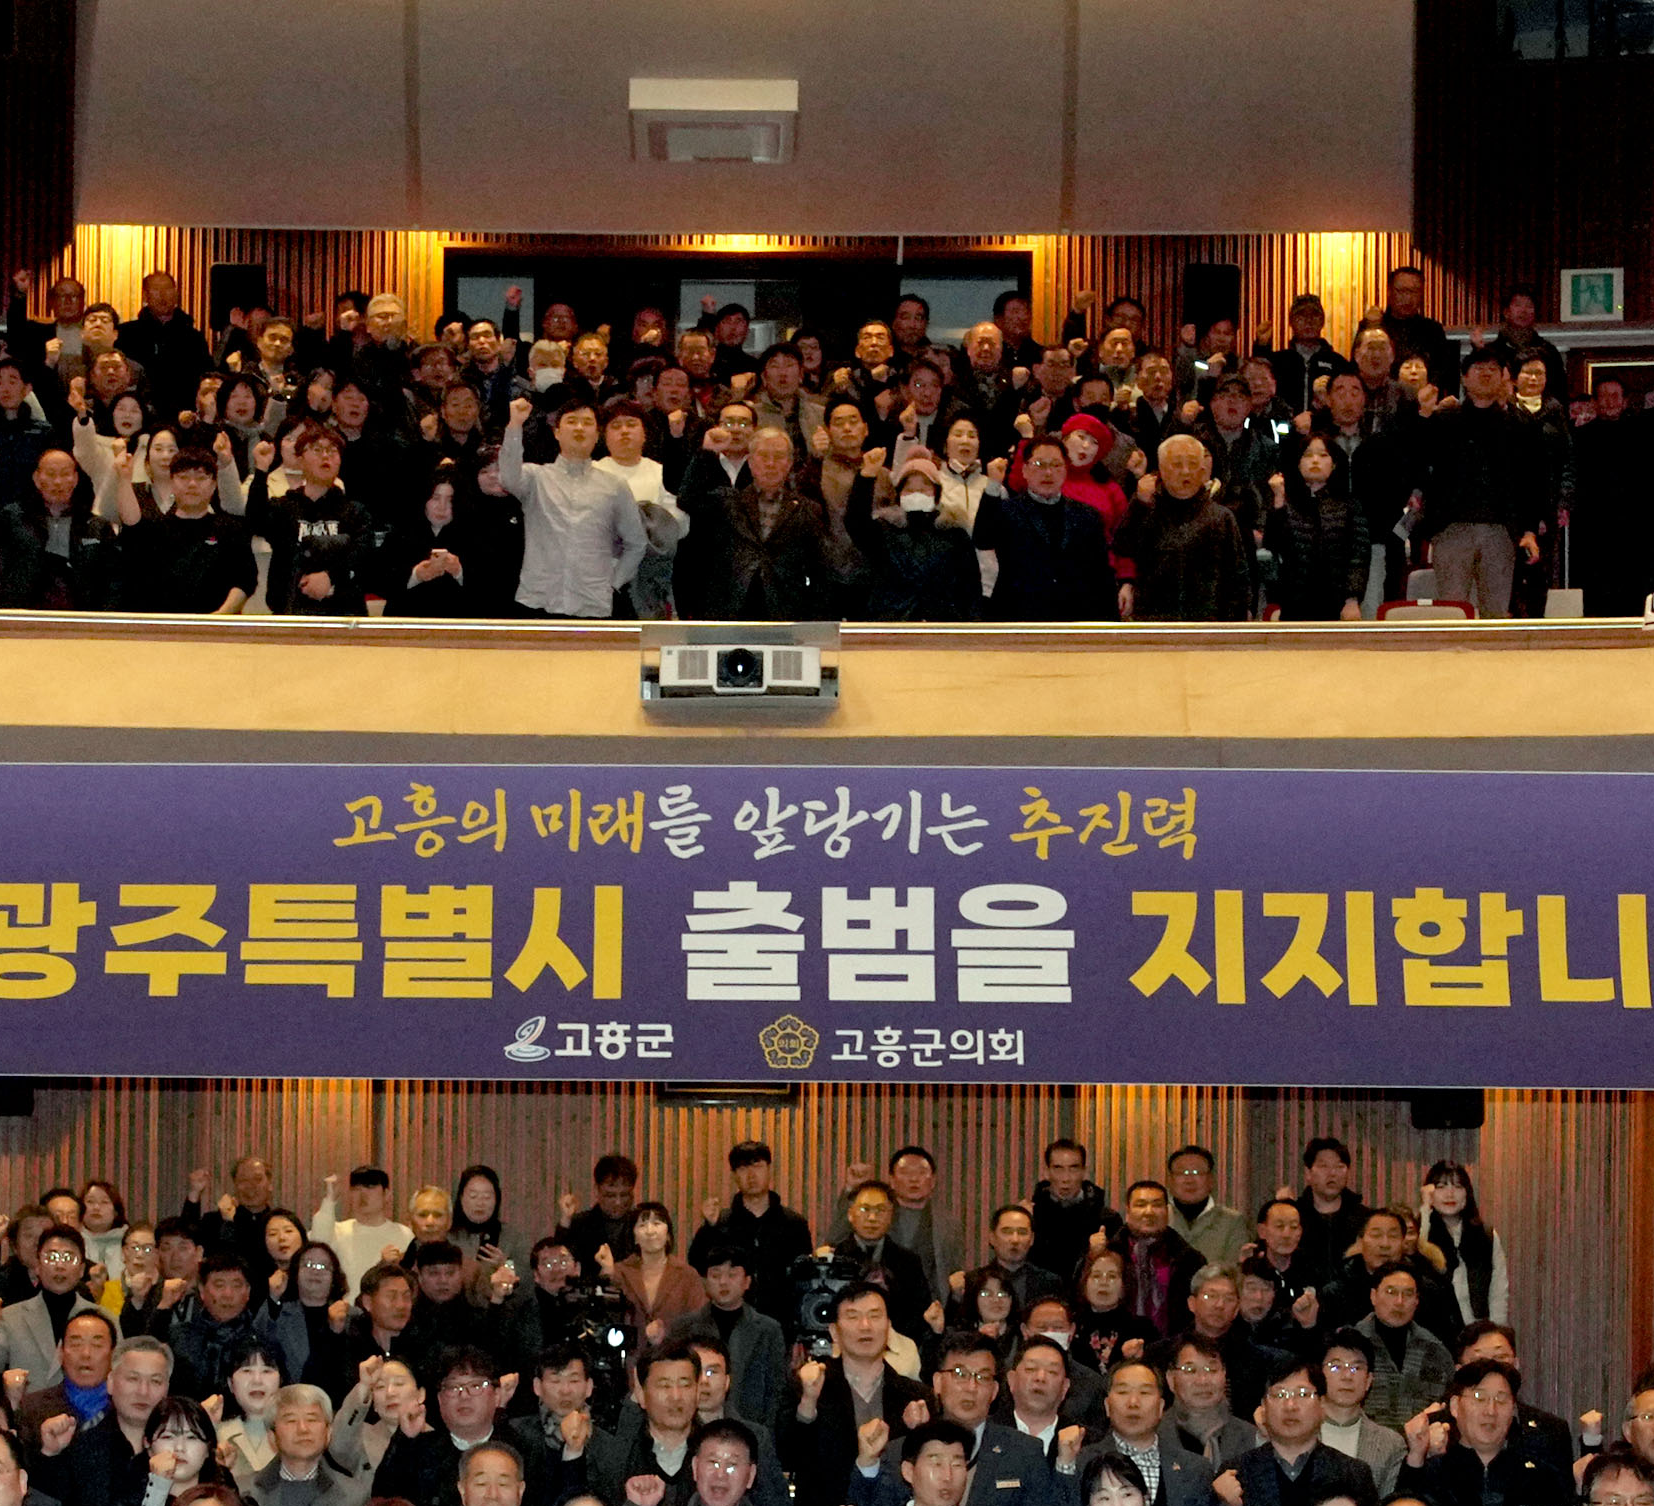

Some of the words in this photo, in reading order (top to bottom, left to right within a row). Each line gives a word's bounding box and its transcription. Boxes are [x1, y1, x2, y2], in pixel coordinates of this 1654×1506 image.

[332, 782, 508, 858] 고흥의
[530, 784, 713, 859] 미래를
[733, 785, 990, 861] 앞당기는
[1009, 786, 1197, 861] 추진력
[681, 880, 1076, 1003] 출범을
[554, 1021, 674, 1060] 고흥군
[830, 1025, 1026, 1068] 고흥군의회
